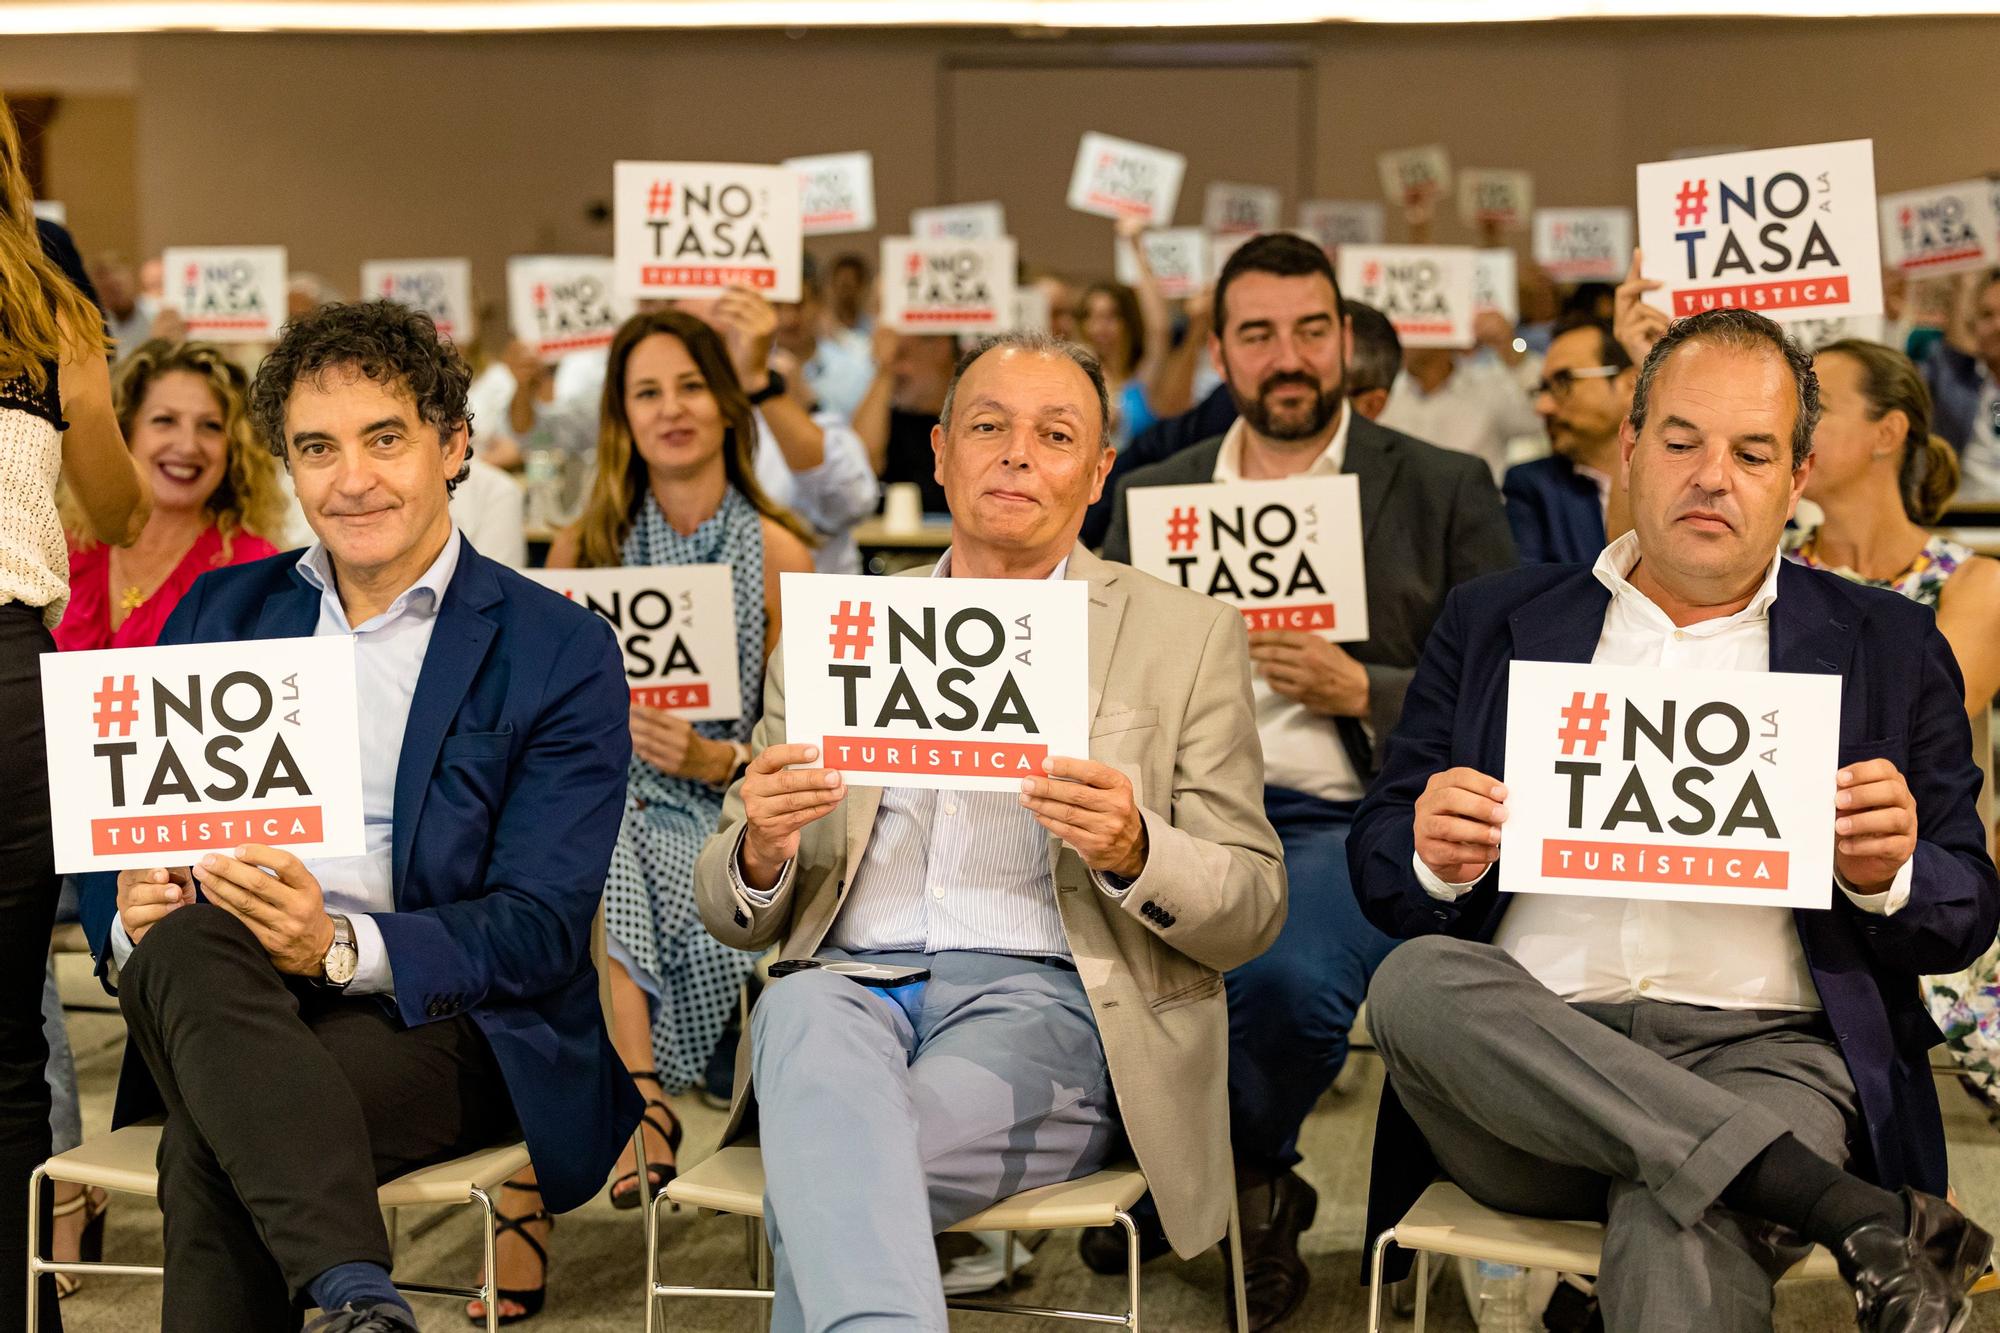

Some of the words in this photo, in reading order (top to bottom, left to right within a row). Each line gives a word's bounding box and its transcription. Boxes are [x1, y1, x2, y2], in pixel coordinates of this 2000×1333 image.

[648, 181, 752, 218] #NO
[1675, 172, 1809, 226] #NO
[1817, 171, 1831, 193] LA
[647, 221, 770, 258] TASA
[1675, 220, 1840, 279] TASA
[1683, 284, 1838, 311] TURÍSTICA
[1166, 504, 1297, 551] #NO
[1168, 551, 1326, 599] TASA
[829, 601, 1006, 668] #NO
[1014, 613, 1032, 641] LA
[1014, 649, 1032, 666] A
[93, 671, 273, 737] #NO
[281, 672, 300, 701] LA
[828, 664, 1040, 734] TASA
[283, 709, 301, 726] A
[1558, 692, 1750, 766] #NO
[1759, 709, 1779, 738] LA
[93, 732, 313, 807] TASA
[838, 745, 1032, 771] TURÍSTICA
[1759, 748, 1778, 766] A
[1555, 760, 1781, 839] TASA
[108, 817, 306, 846] TURÍSTICA
[1560, 849, 1770, 880] TURÍSTICA
